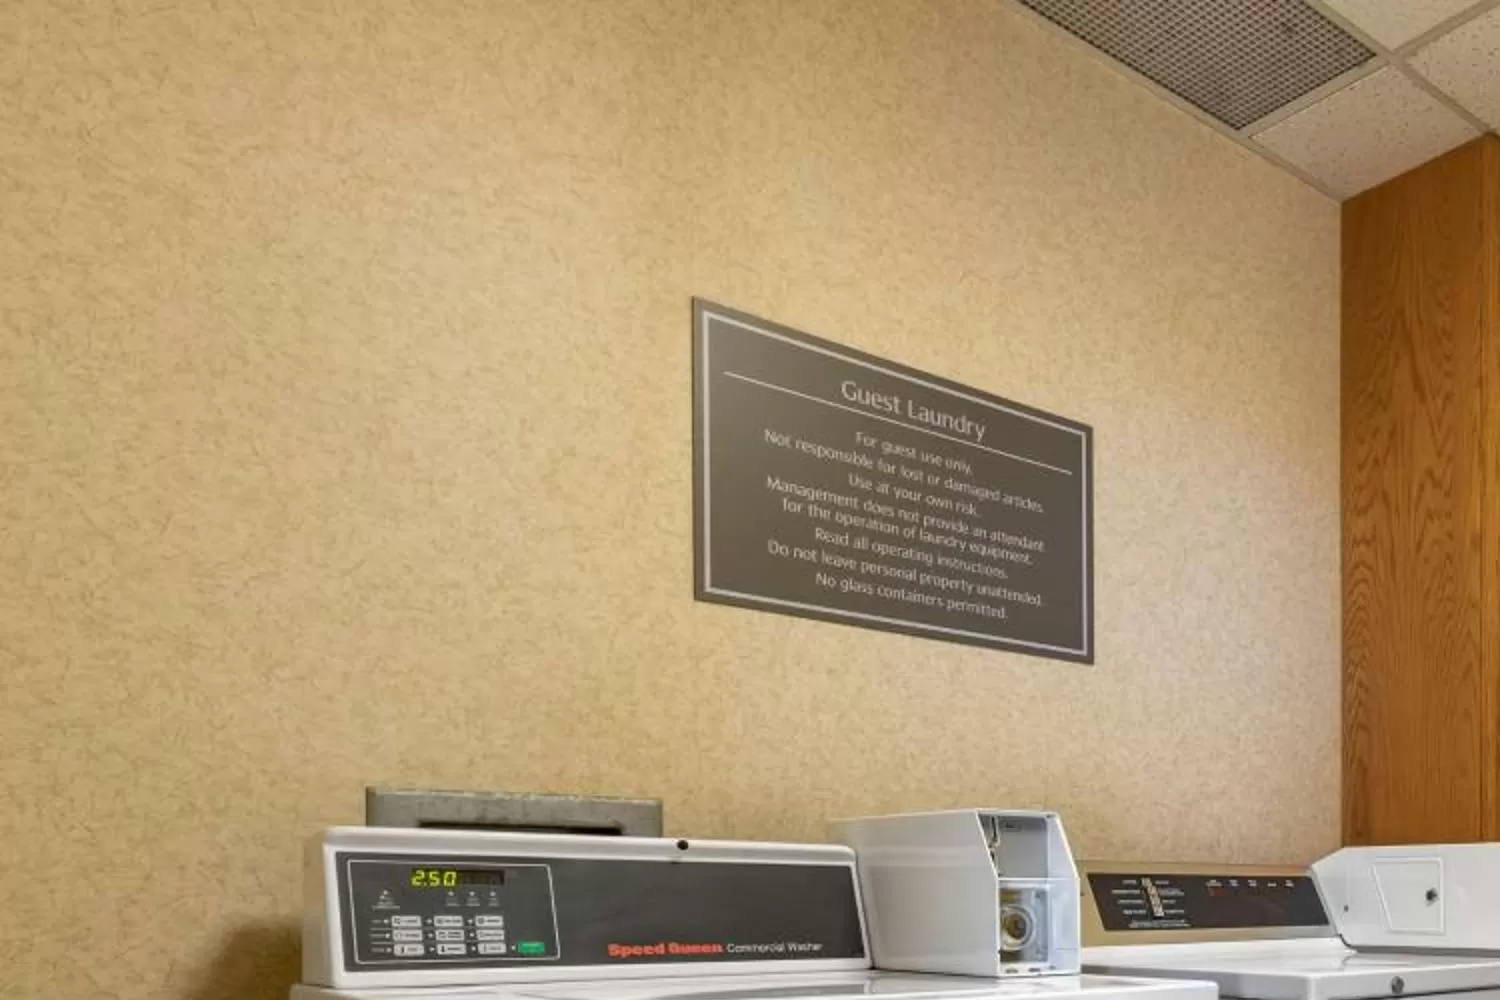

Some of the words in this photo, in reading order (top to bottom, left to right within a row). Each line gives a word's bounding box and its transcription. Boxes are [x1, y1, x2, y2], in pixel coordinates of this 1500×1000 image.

[841, 380, 901, 415] Guest
[907, 399, 985, 442] Laundry
[763, 428, 791, 448] Not
[795, 439, 873, 469] responsible
[877, 458, 896, 474] for
[901, 465, 923, 482] lost
[927, 474, 941, 486] or
[944, 476, 1000, 501] damaged
[855, 431, 879, 449] For
[881, 440, 917, 459] guest
[921, 451, 943, 467] use
[767, 474, 858, 509] Management
[863, 499, 894, 517] does
[898, 508, 919, 523] not
[923, 514, 969, 534] provide
[973, 527, 987, 539] an
[848, 472, 872, 490] Use
[875, 481, 889, 494] at
[893, 486, 922, 502] your
[925, 494, 953, 509] own
[956, 501, 981, 517] risk.
[782, 497, 804, 513] for
[808, 503, 831, 520] the
[835, 511, 899, 536] operation
[903, 525, 916, 539] of
[919, 527, 967, 552] laundry
[969, 542, 1033, 564] equipment.
[815, 526, 849, 546] Read
[853, 536, 869, 550] all
[871, 541, 933, 566] operating
[937, 554, 1008, 579] instructions.
[767, 539, 789, 557] Do
[793, 547, 817, 562] not
[821, 549, 857, 569] leave
[861, 560, 917, 581] personal
[919, 571, 974, 595] property
[815, 572, 837, 588] No
[840, 578, 873, 594] glass
[877, 585, 944, 606] containers
[946, 599, 1008, 619] permitted.
[411, 869, 457, 887] 2.50
[608, 942, 666, 958] Speed
[668, 941, 724, 955] Queen
[727, 942, 785, 953] Commercial
[788, 941, 823, 952] Washer
